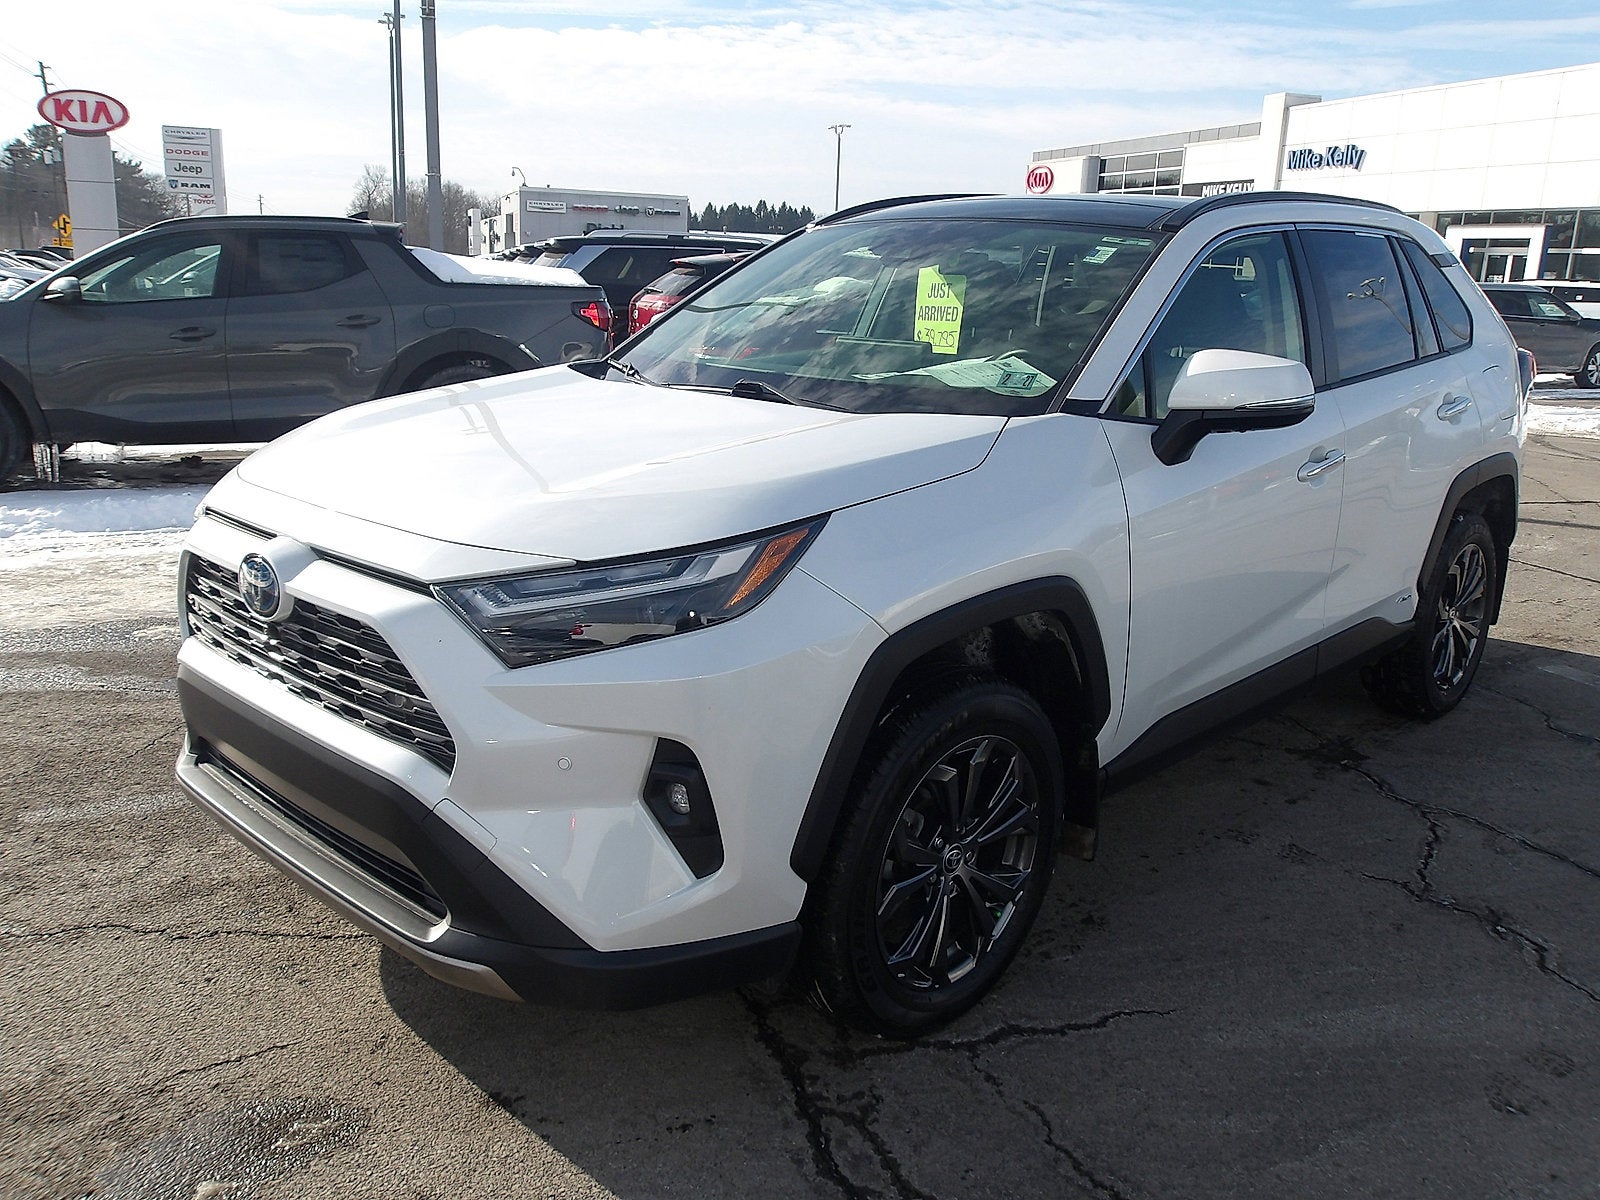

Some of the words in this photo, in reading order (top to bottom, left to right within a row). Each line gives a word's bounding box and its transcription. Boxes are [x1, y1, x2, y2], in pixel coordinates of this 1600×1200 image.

[53, 98, 115, 125] KIA
[166, 148, 209, 157] DODGE
[1286, 149, 1323, 171] Mike
[1325, 144, 1366, 171] Kelly
[173, 162, 203, 175] Jeep
[1030, 172, 1049, 188] KIA
[1201, 184, 1226, 198] MIKE
[928, 282, 953, 299] JUST
[918, 305, 959, 322] ARRIVED
